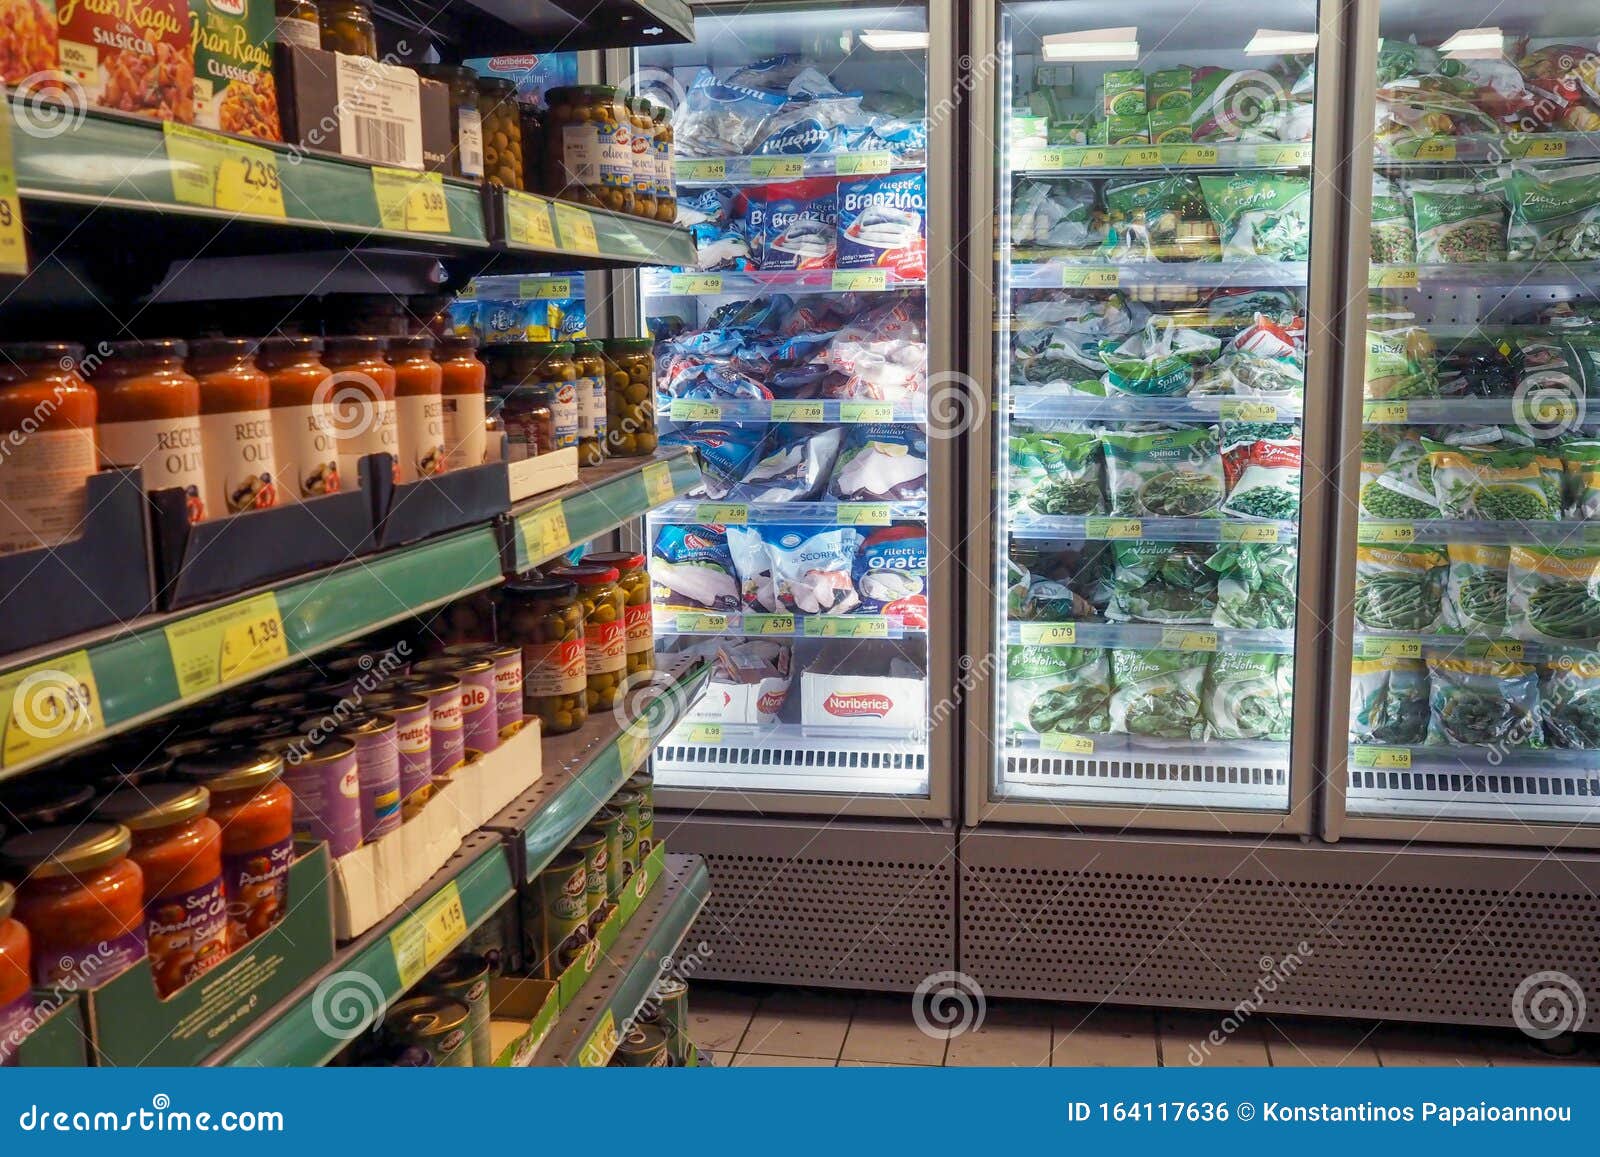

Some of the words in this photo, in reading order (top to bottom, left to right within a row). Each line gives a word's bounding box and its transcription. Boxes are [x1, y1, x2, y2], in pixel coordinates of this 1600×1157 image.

[92, 25, 156, 57] SALSICCIA
[207, 58, 257, 86] CLASSICO
[1543, 142, 1563, 151] 2,39
[240, 155, 281, 191] 2,39
[868, 555, 927, 570] Orata
[772, 618, 793, 629] 5,79
[1051, 627, 1073, 638] 0,79
[829, 695, 890, 711] Noribérica
[440, 902, 461, 932] 1,15
